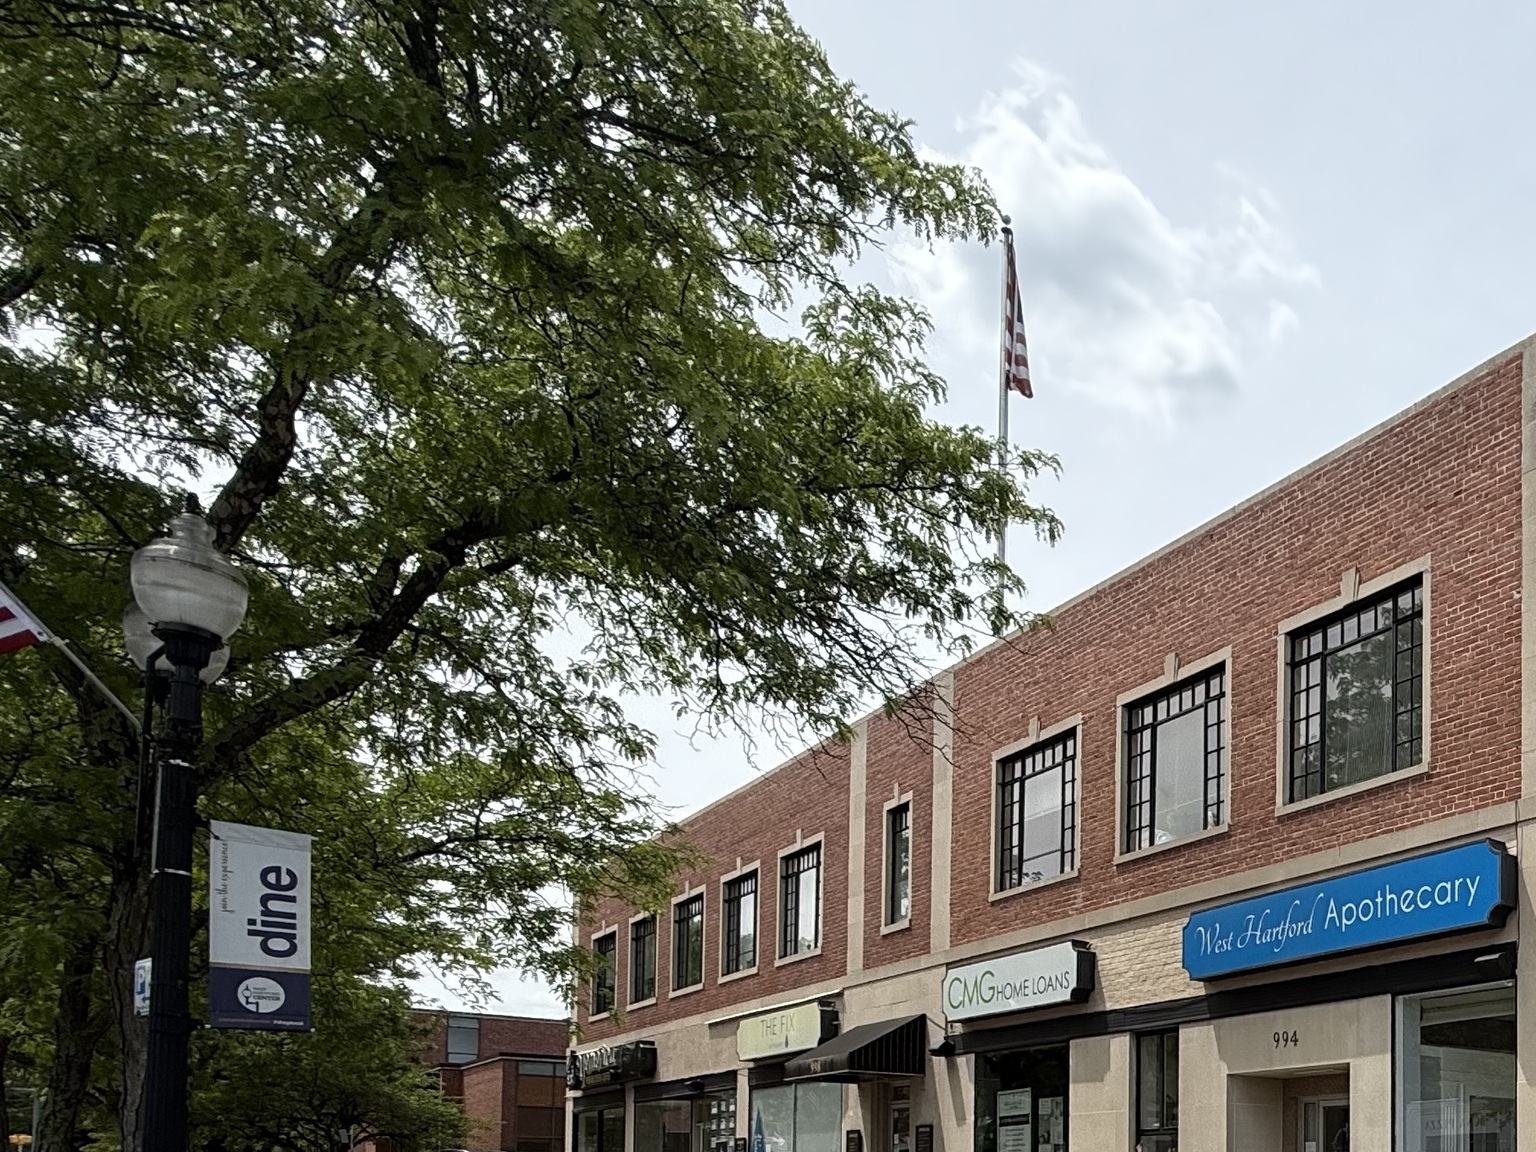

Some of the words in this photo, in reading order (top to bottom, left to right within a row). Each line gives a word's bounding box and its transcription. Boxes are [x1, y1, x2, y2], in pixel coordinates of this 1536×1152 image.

[247, 865, 298, 959] dine
[1195, 922, 1233, 956] West
[1237, 892, 1324, 953] Hartford
[1324, 874, 1481, 932] Apothecary
[948, 970, 996, 1010] CMG
[996, 979, 1029, 1002] HOME
[1032, 970, 1070, 996] LOANS
[760, 1017, 777, 1038] THE
[780, 1012, 796, 1033] FIX
[1272, 1029, 1299, 1049] 994
